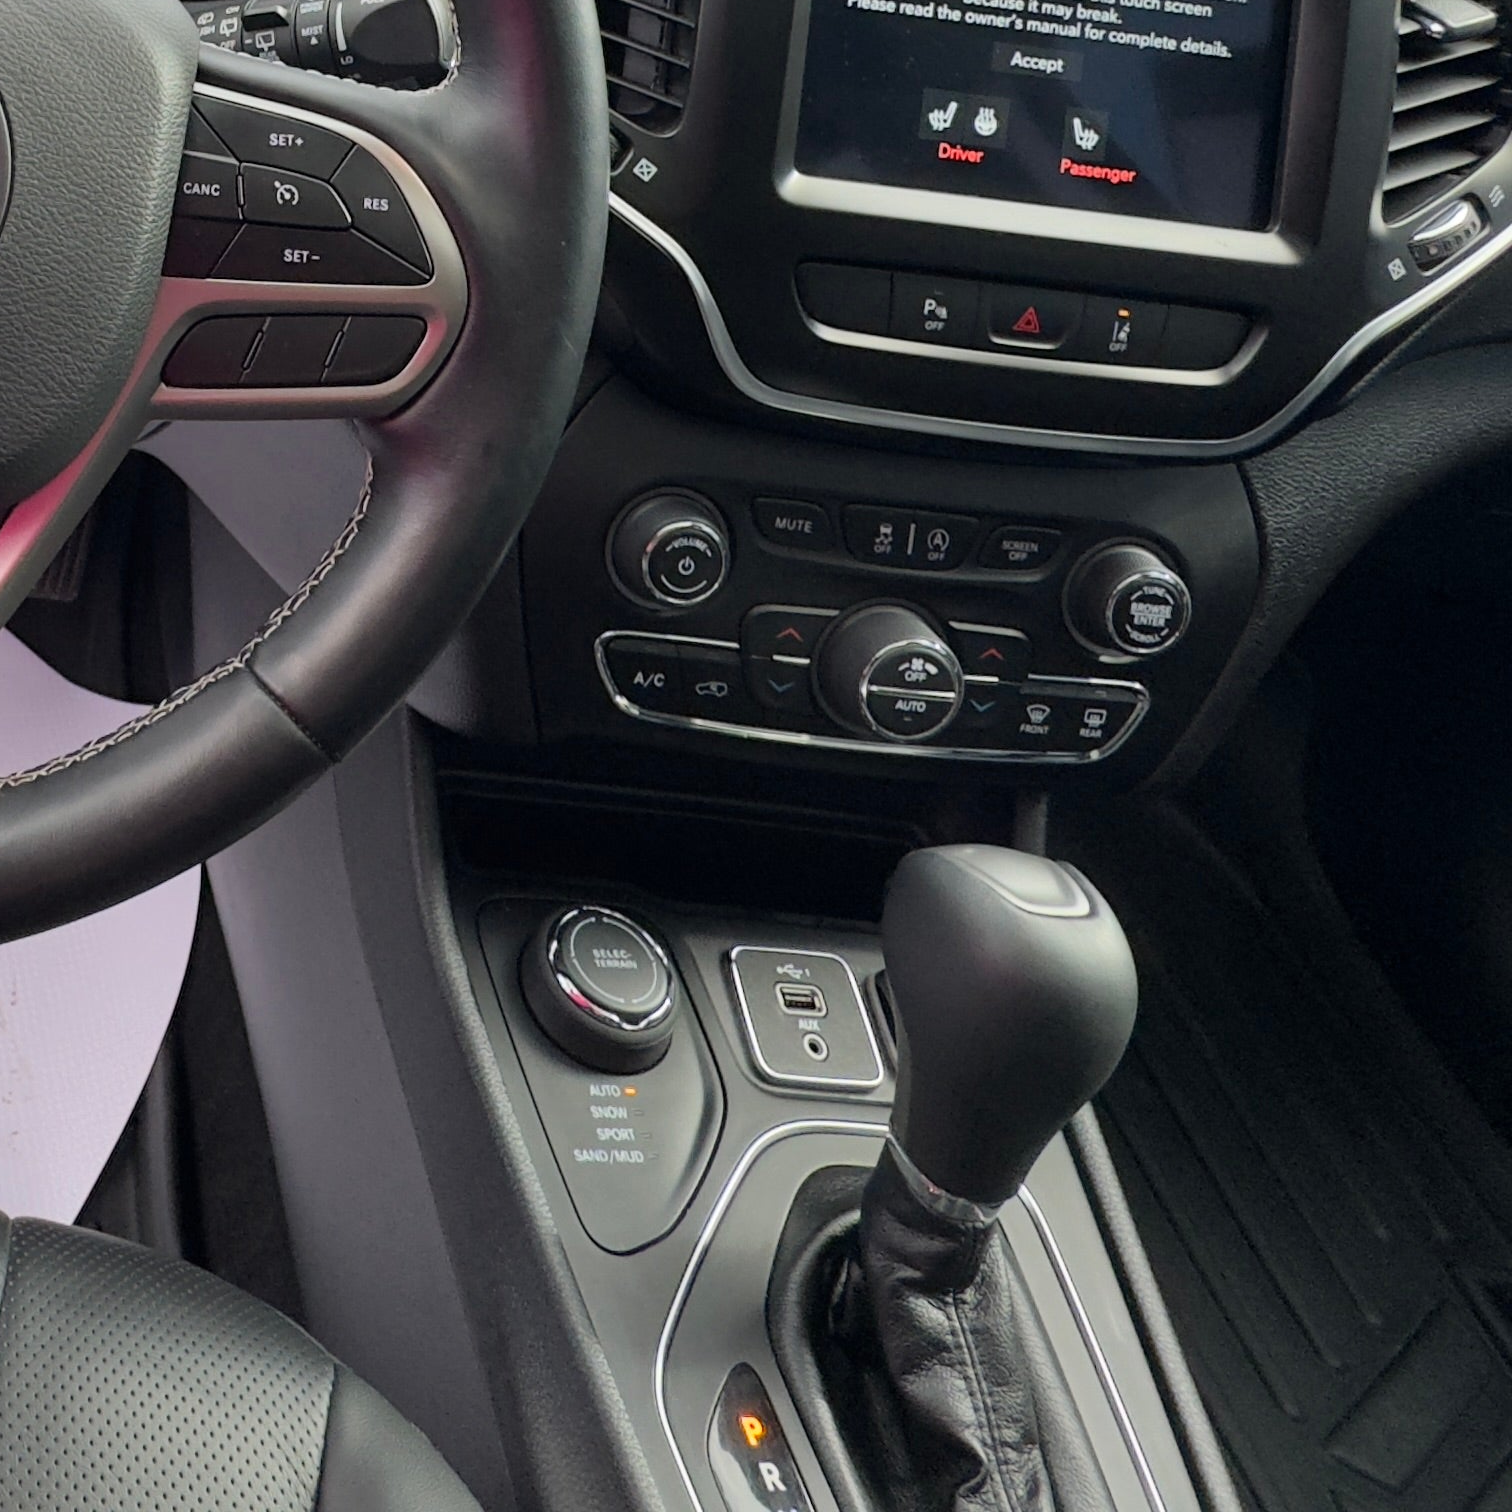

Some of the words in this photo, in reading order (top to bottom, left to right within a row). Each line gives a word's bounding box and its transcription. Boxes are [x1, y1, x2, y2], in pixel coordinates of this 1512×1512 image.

[1041, 3, 1073, 20] may
[1077, 4, 1122, 23] break.
[1164, 0, 1212, 17] screen
[301, 24, 324, 37] MIST
[899, 2, 934, 18] read
[938, 4, 961, 21] the
[965, 11, 1023, 30] owner's
[1026, 19, 1081, 38] manual
[1085, 23, 1105, 41] for
[1109, 31, 1177, 50] complete
[1180, 37, 1231, 58] details.
[340, 54, 354, 66] LO
[1009, 50, 1065, 74] Accept
[268, 131, 304, 149] SET+
[938, 142, 985, 165] Driver
[1059, 158, 1137, 185] Passenger
[183, 181, 221, 197] CANC
[363, 196, 389, 212] RES
[924, 320, 945, 331] OFF
[1109, 342, 1128, 353] OFF
[774, 516, 814, 534] MUTE
[670, 537, 709, 552] VOLUME
[873, 543, 892, 554] OFF
[1001, 540, 1039, 553] SCREEN
[927, 550, 946, 562] OFF
[1008, 551, 1029, 562] OFF
[1130, 602, 1172, 619] BROWSE
[1134, 615, 1167, 628] ENTER
[633, 671, 666, 688] A/C
[903, 670, 928, 684] OFF
[894, 698, 927, 713] AUTO
[1019, 723, 1050, 736] FRONT
[1079, 727, 1103, 739] REAR
[798, 1018, 821, 1032] AUX
[589, 1084, 622, 1098] AUTO
[589, 1105, 629, 1121] SNOW
[596, 1127, 636, 1142] SPORT
[573, 1148, 645, 1164] SAND/MUD
[739, 1414, 766, 1447] P
[758, 1461, 787, 1493] R
